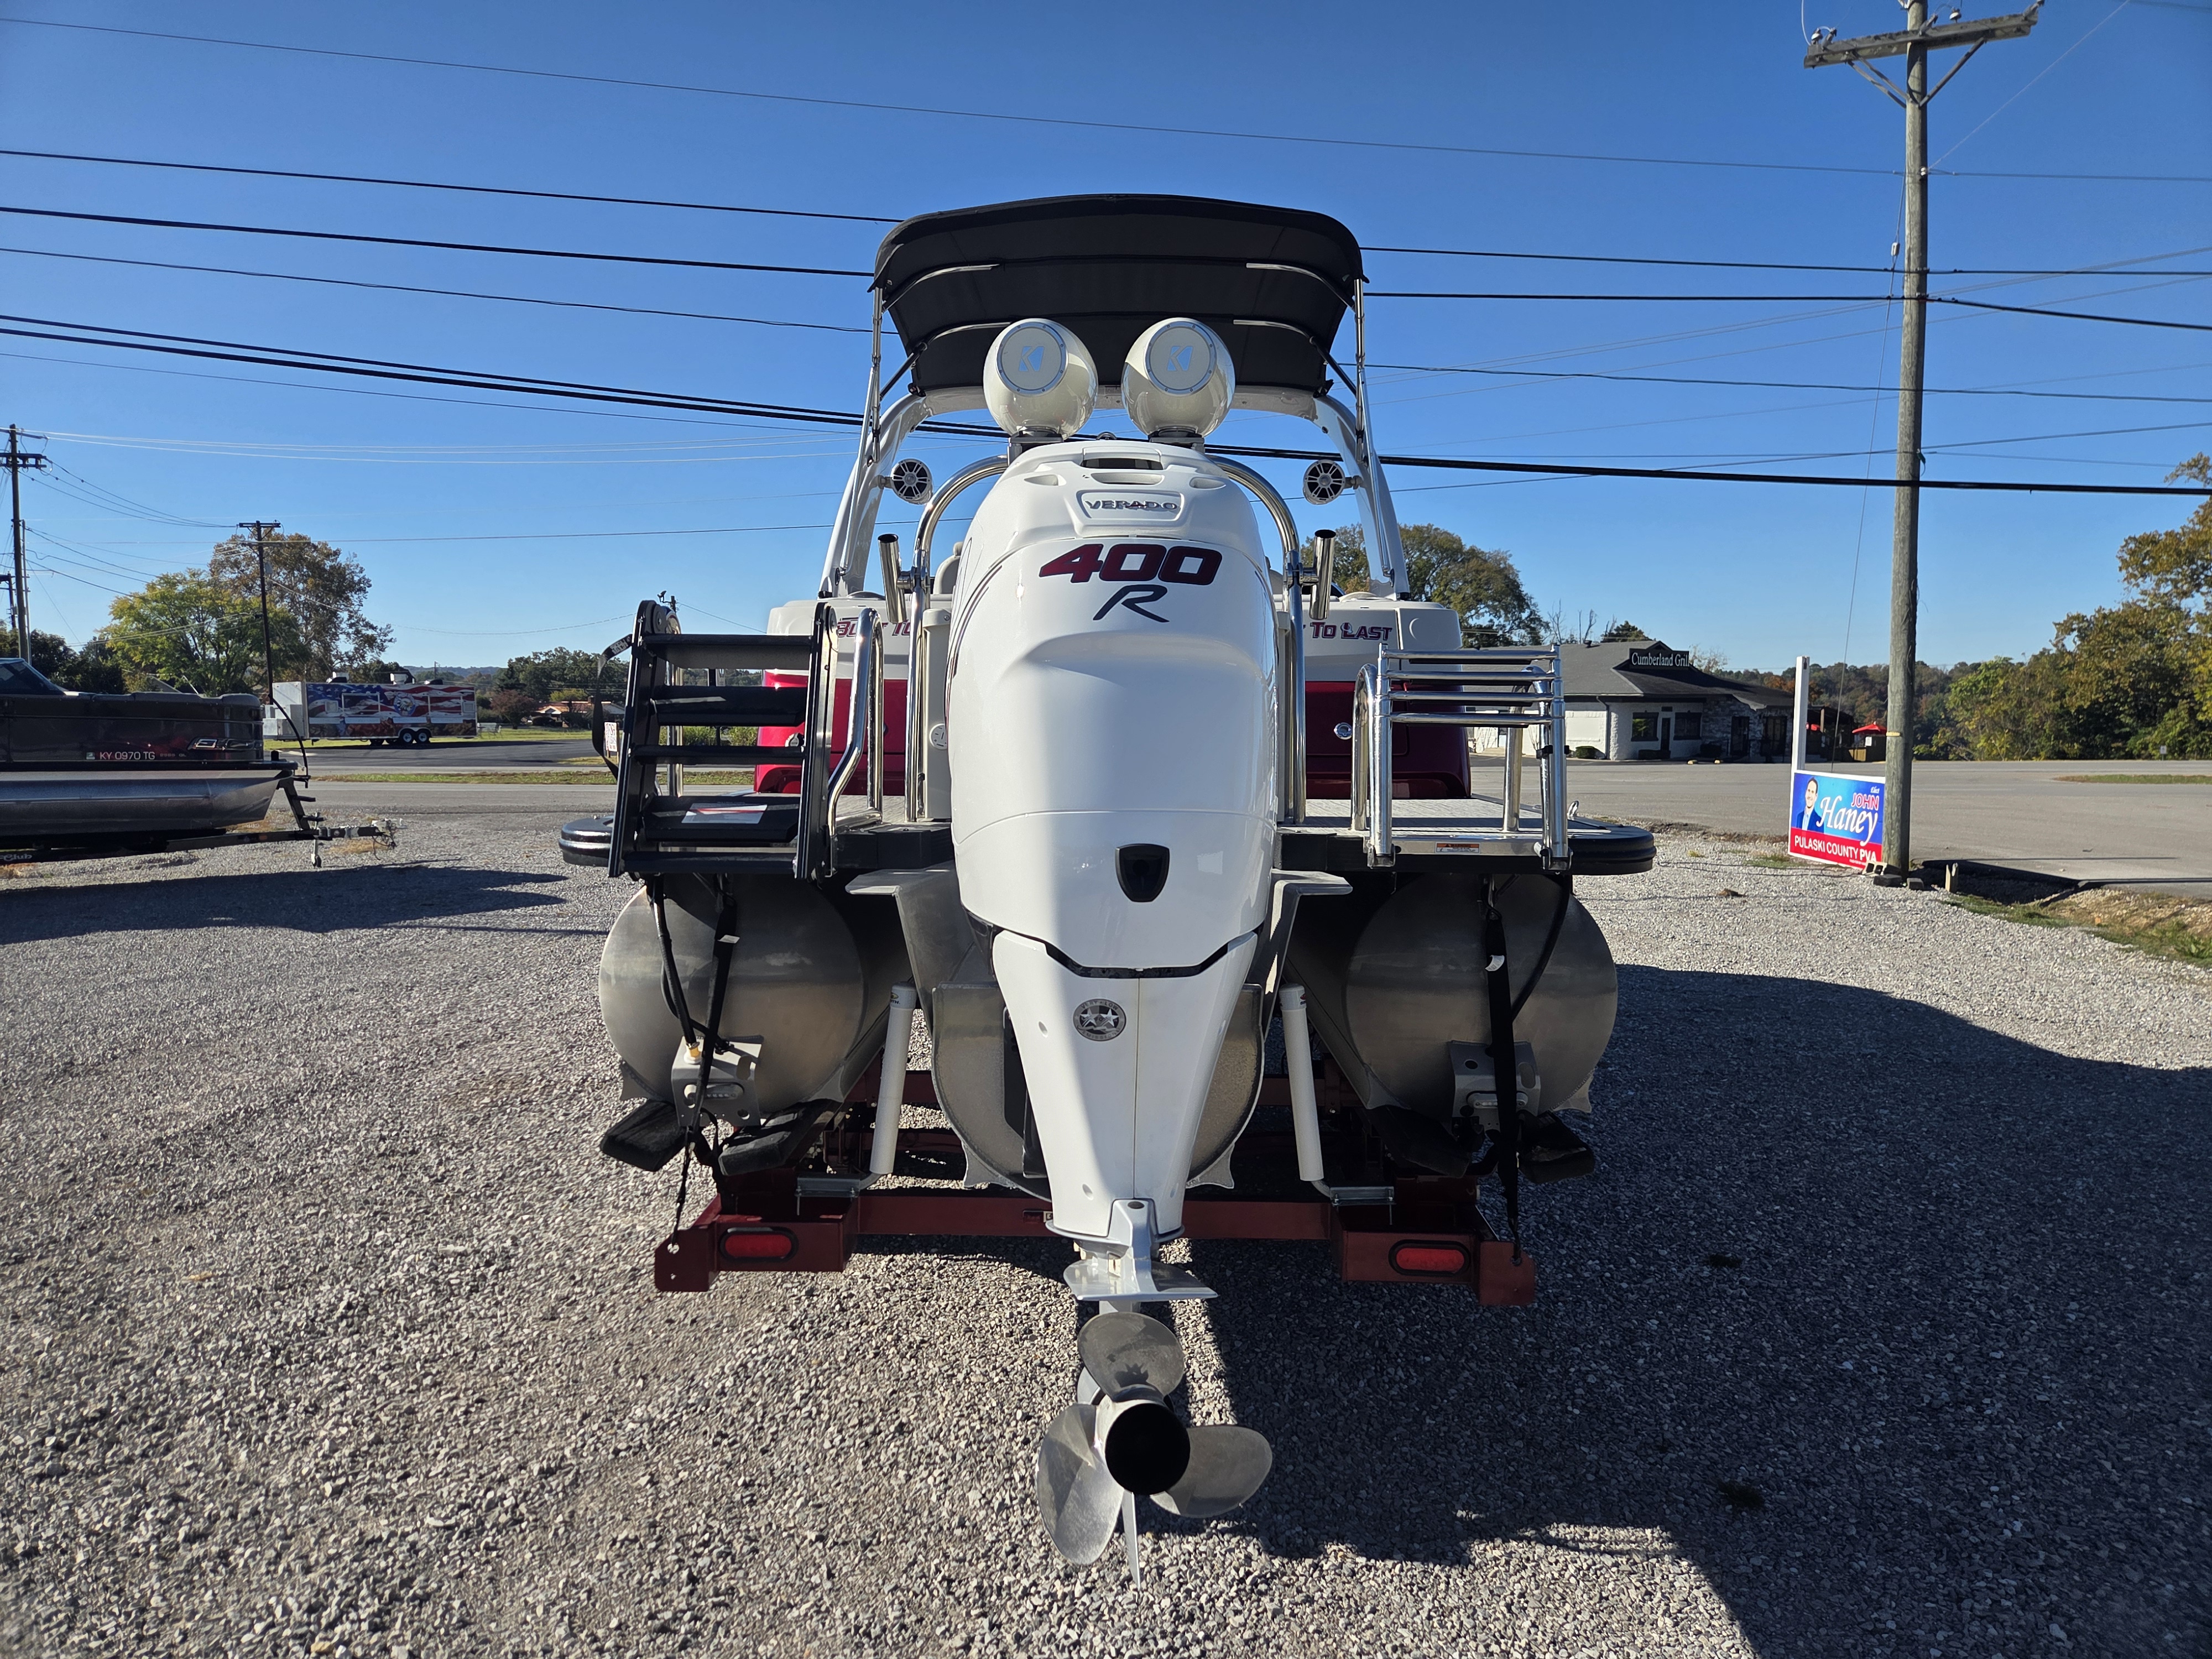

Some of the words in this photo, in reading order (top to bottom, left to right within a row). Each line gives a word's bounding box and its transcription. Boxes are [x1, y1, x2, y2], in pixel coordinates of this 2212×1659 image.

[1084, 500, 1177, 509] VERADO
[1039, 544, 1223, 586] 400
[1093, 584, 1170, 623] R
[1631, 652, 1673, 666] Cumberland
[1674, 654, 1690, 667] Grill
[100, 752, 111, 760] KY
[114, 752, 141, 760] 0970
[143, 752, 155, 760] TG
[1851, 792, 1879, 811] JOHN
[1816, 795, 1878, 847] Haney
[1794, 835, 1825, 853] PULASKI
[1826, 842, 1859, 859] COUNTY
[1859, 848, 1877, 862] PVA
[1104, 1000, 1119, 1010] LOW
